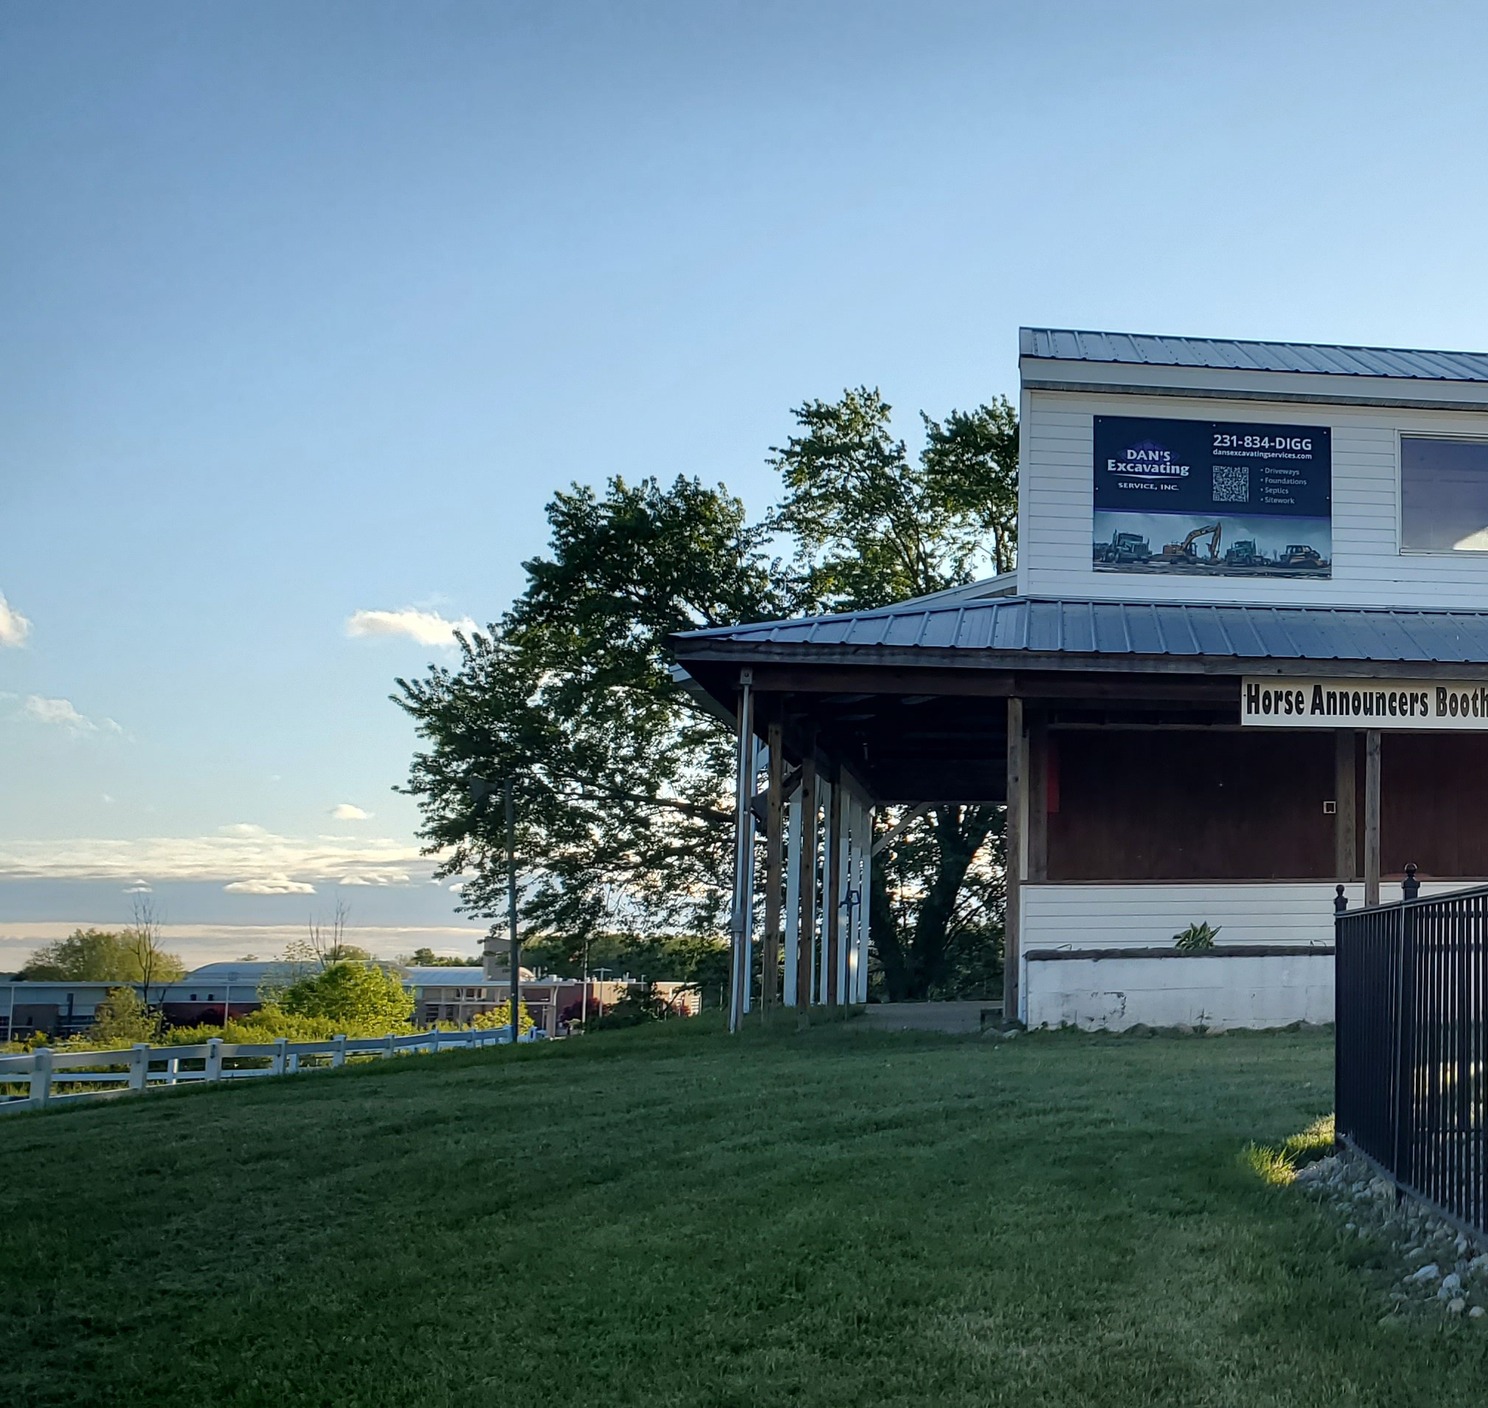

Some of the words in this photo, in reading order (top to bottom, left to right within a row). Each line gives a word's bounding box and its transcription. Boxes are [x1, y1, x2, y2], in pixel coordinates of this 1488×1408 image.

[1213, 434, 1312, 451] 231-834-DIGG
[1126, 449, 1171, 461] DAN'S
[1212, 448, 1313, 460] dansexcavatingservices.com
[1107, 459, 1190, 476] Excavating
[1264, 467, 1300, 476] Driveways
[1118, 482, 1158, 490] SERVICE,
[1264, 477, 1307, 486] Foundations
[1264, 487, 1289, 495] Septics
[1264, 496, 1295, 505] Sitework
[1246, 683, 1304, 715] Horse
[1310, 684, 1429, 717] Announcers
